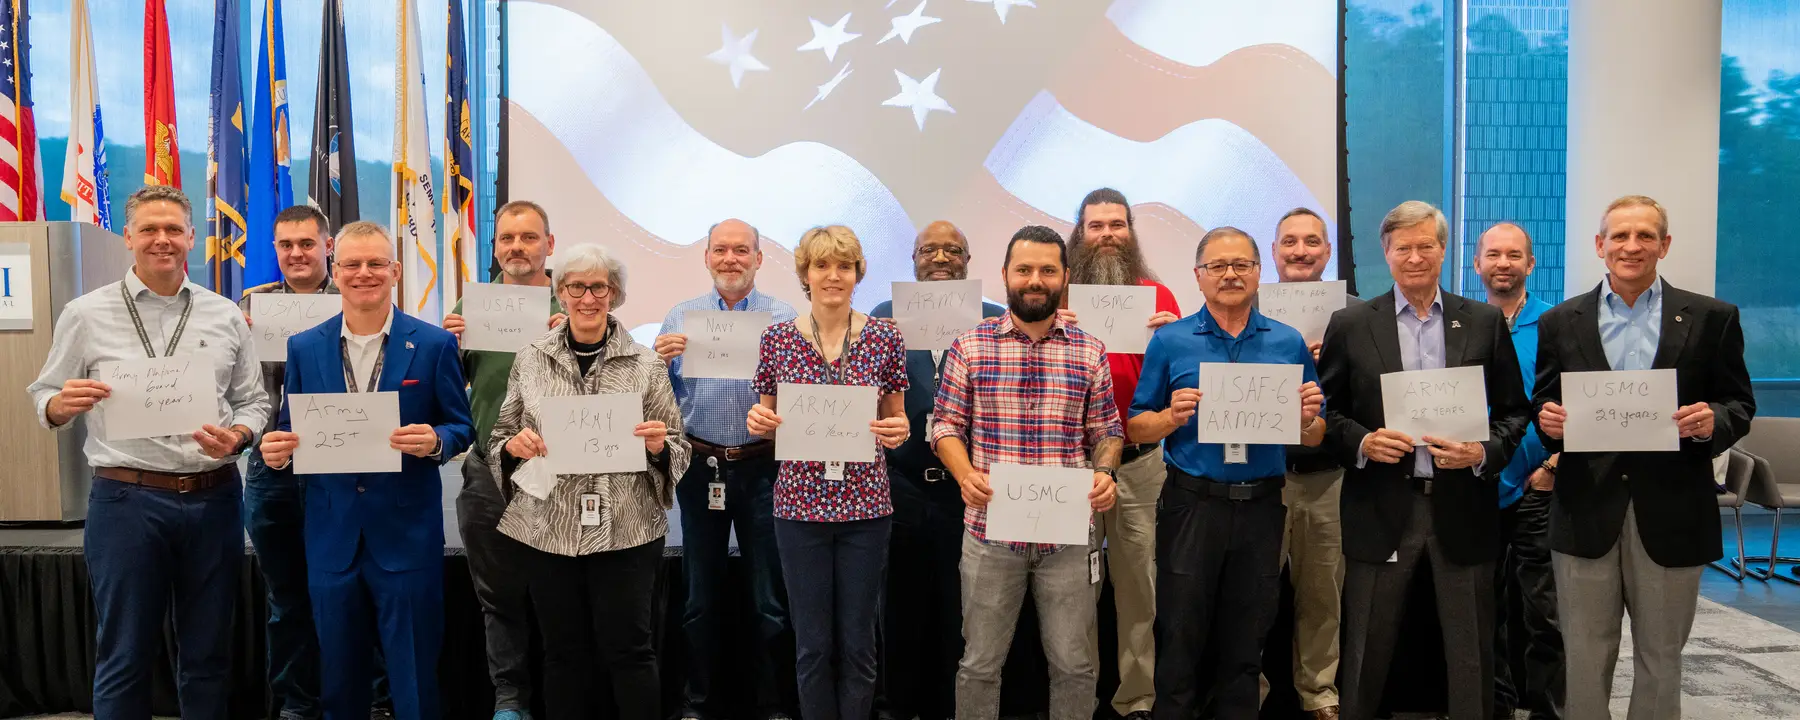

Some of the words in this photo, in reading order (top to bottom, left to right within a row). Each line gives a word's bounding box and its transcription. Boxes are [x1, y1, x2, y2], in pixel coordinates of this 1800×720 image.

[257, 299, 321, 319] USMC
[483, 297, 526, 312] USAF
[906, 291, 968, 312] ARMY
[1091, 294, 1134, 311] USMC
[497, 327, 522, 335] years
[920, 324, 928, 337] 4
[1104, 315, 1114, 335] 4
[264, 327, 274, 341] 6
[112, 365, 138, 386] Army
[146, 361, 190, 379] National
[146, 378, 178, 392] Guard
[1403, 381, 1460, 399] ARMY
[1583, 381, 1649, 398] USMC
[145, 396, 152, 408] 6
[305, 396, 369, 421] Army
[789, 393, 852, 417] ARMY
[564, 407, 613, 432] ARMY
[1411, 408, 1427, 420] 28
[1433, 405, 1465, 416] YEARS
[1595, 408, 1616, 422] 29
[805, 422, 816, 436] 6
[825, 423, 860, 438] Years
[584, 438, 600, 453] 13
[604, 444, 620, 458] yrs
[1007, 483, 1068, 504] USMC
[1027, 509, 1041, 533] 4
